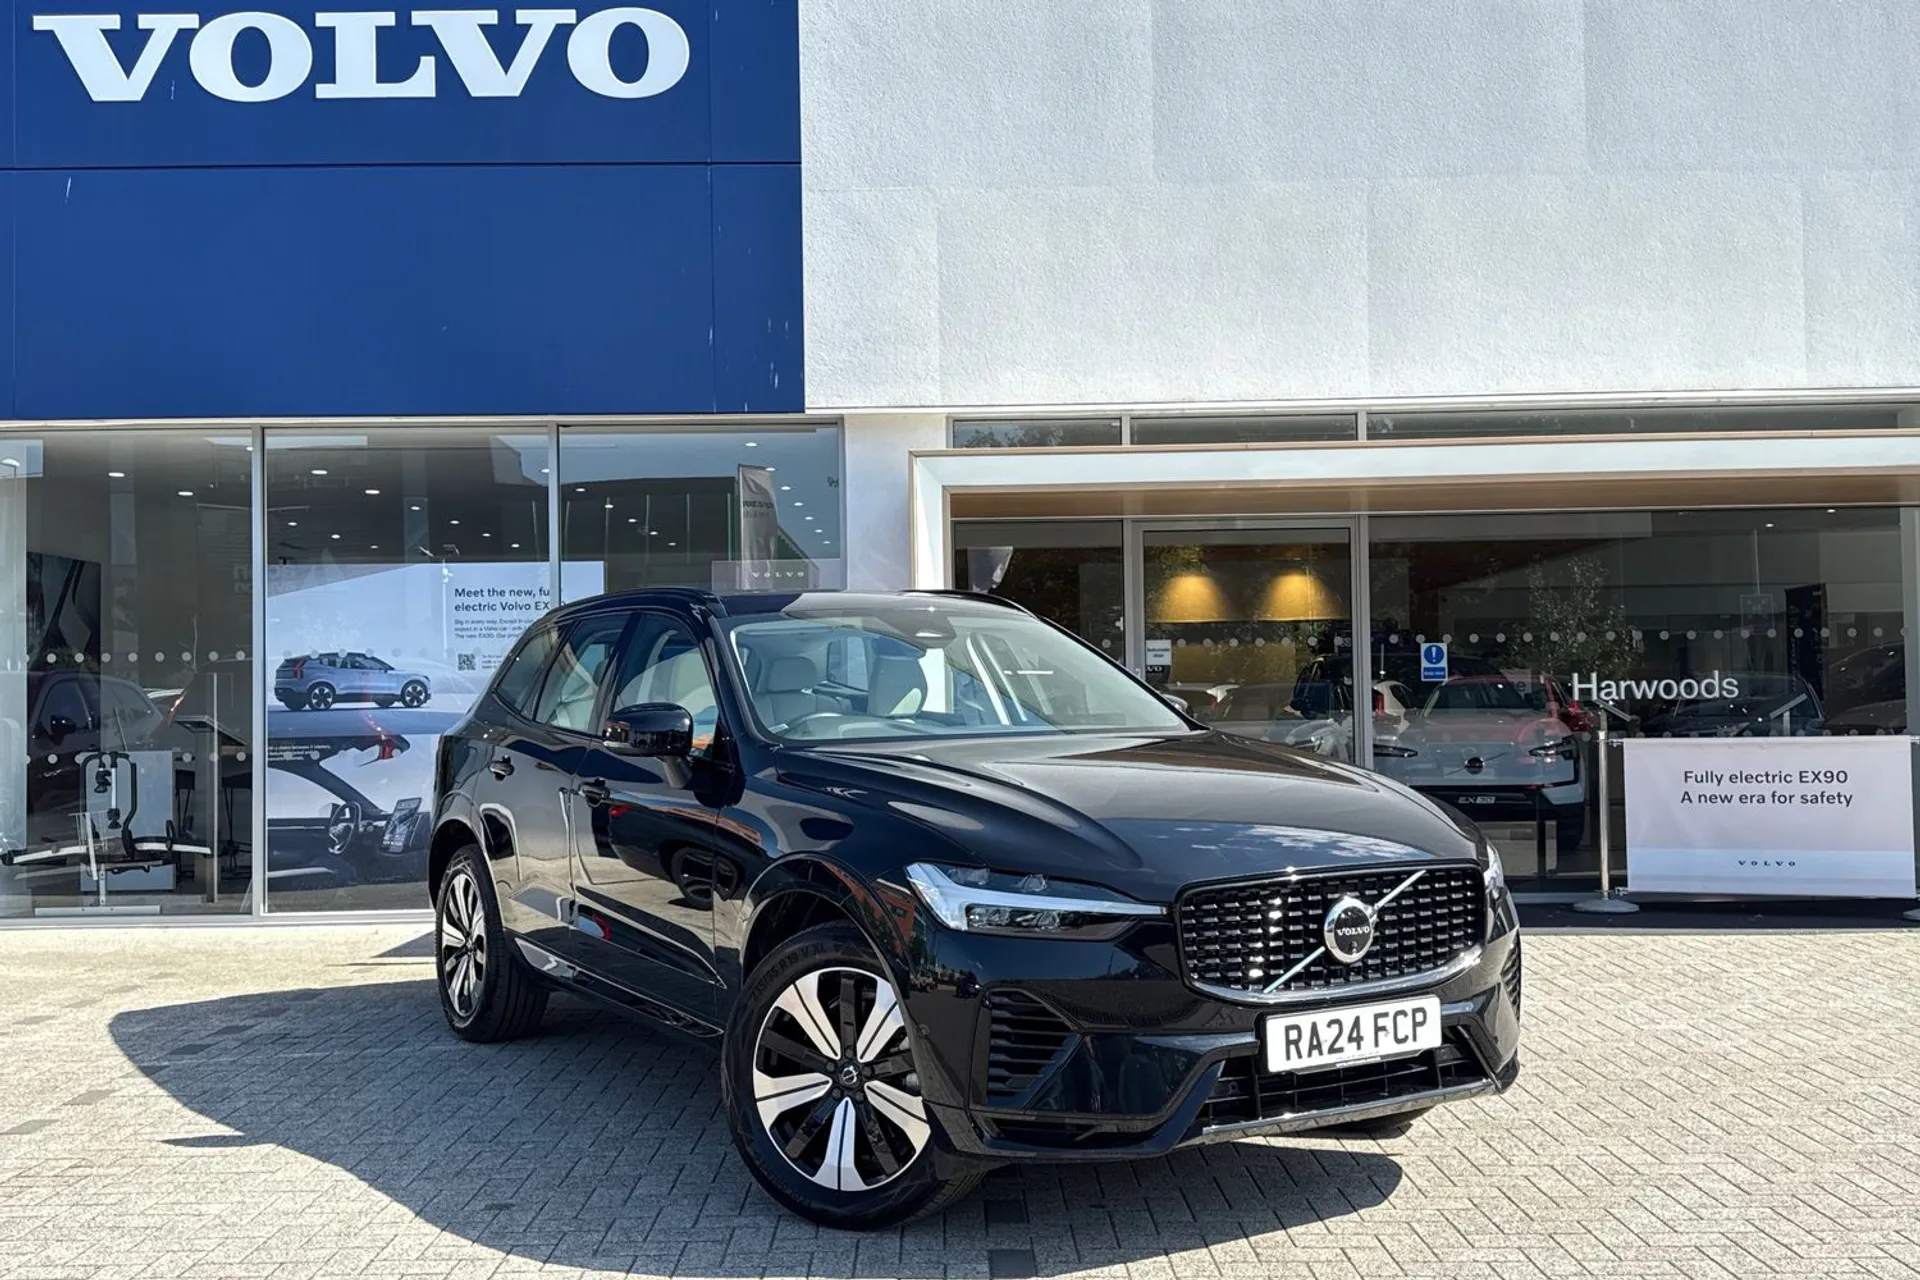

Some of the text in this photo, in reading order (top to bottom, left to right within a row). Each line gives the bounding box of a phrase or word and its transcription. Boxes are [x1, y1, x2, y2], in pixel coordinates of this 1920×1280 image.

[32, 7, 690, 103] VOLVO
[454, 588, 485, 598] Meet
[487, 587, 506, 598] the
[509, 588, 536, 599] new,
[454, 601, 498, 612] electric
[500, 601, 531, 611] Volvo
[1572, 670, 1739, 702] Harwoods
[1683, 769, 1848, 787] Fully electric EX90
[1680, 790, 1853, 807] A new era for safety
[1738, 859, 1797, 867] VOLVO
[1336, 926, 1370, 937] VOLVO
[1284, 1006, 1428, 1061] RA24 FCP
